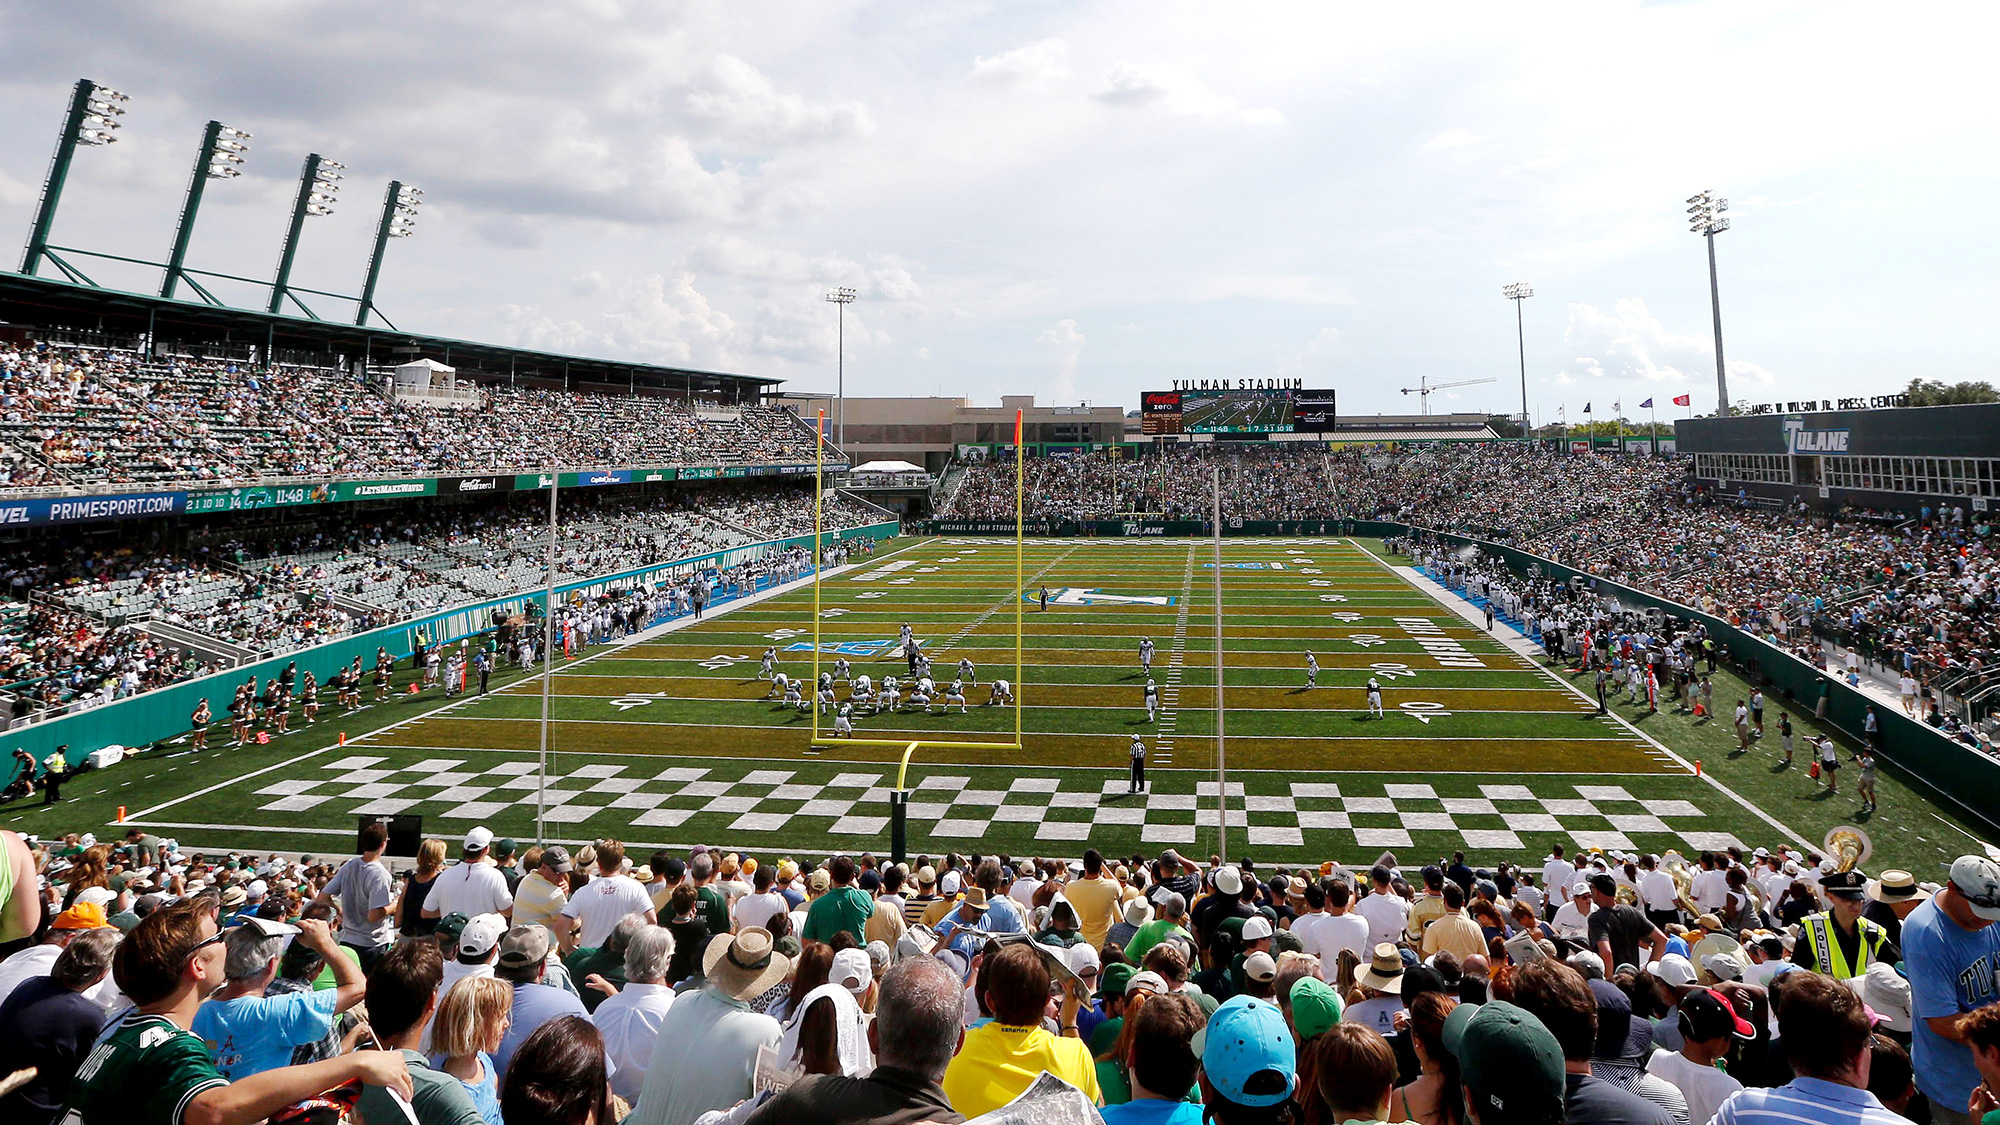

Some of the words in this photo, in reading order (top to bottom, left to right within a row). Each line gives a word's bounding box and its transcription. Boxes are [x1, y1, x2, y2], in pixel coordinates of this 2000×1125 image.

[1173, 379, 1229, 390] YULMAN
[1239, 378, 1302, 389] STADIUM
[1751, 404, 1772, 414] JAMES
[1788, 401, 1817, 412] WILSON
[1821, 400, 1834, 411] JR.
[1837, 398, 1866, 410] PRESS
[1785, 420, 1848, 454] TULANE
[50, 497, 174, 521] PRIMESPORT.COM
[186, 501, 193, 510] 2
[195, 500, 199, 509] 1
[203, 499, 212, 509] 10
[215, 498, 224, 508] 10
[228, 497, 241, 509] 14
[275, 488, 304, 503] 11:48
[330, 490, 337, 501] 7
[1231, 518, 1240, 526] 20
[1816, 926, 1828, 971] POLICE
